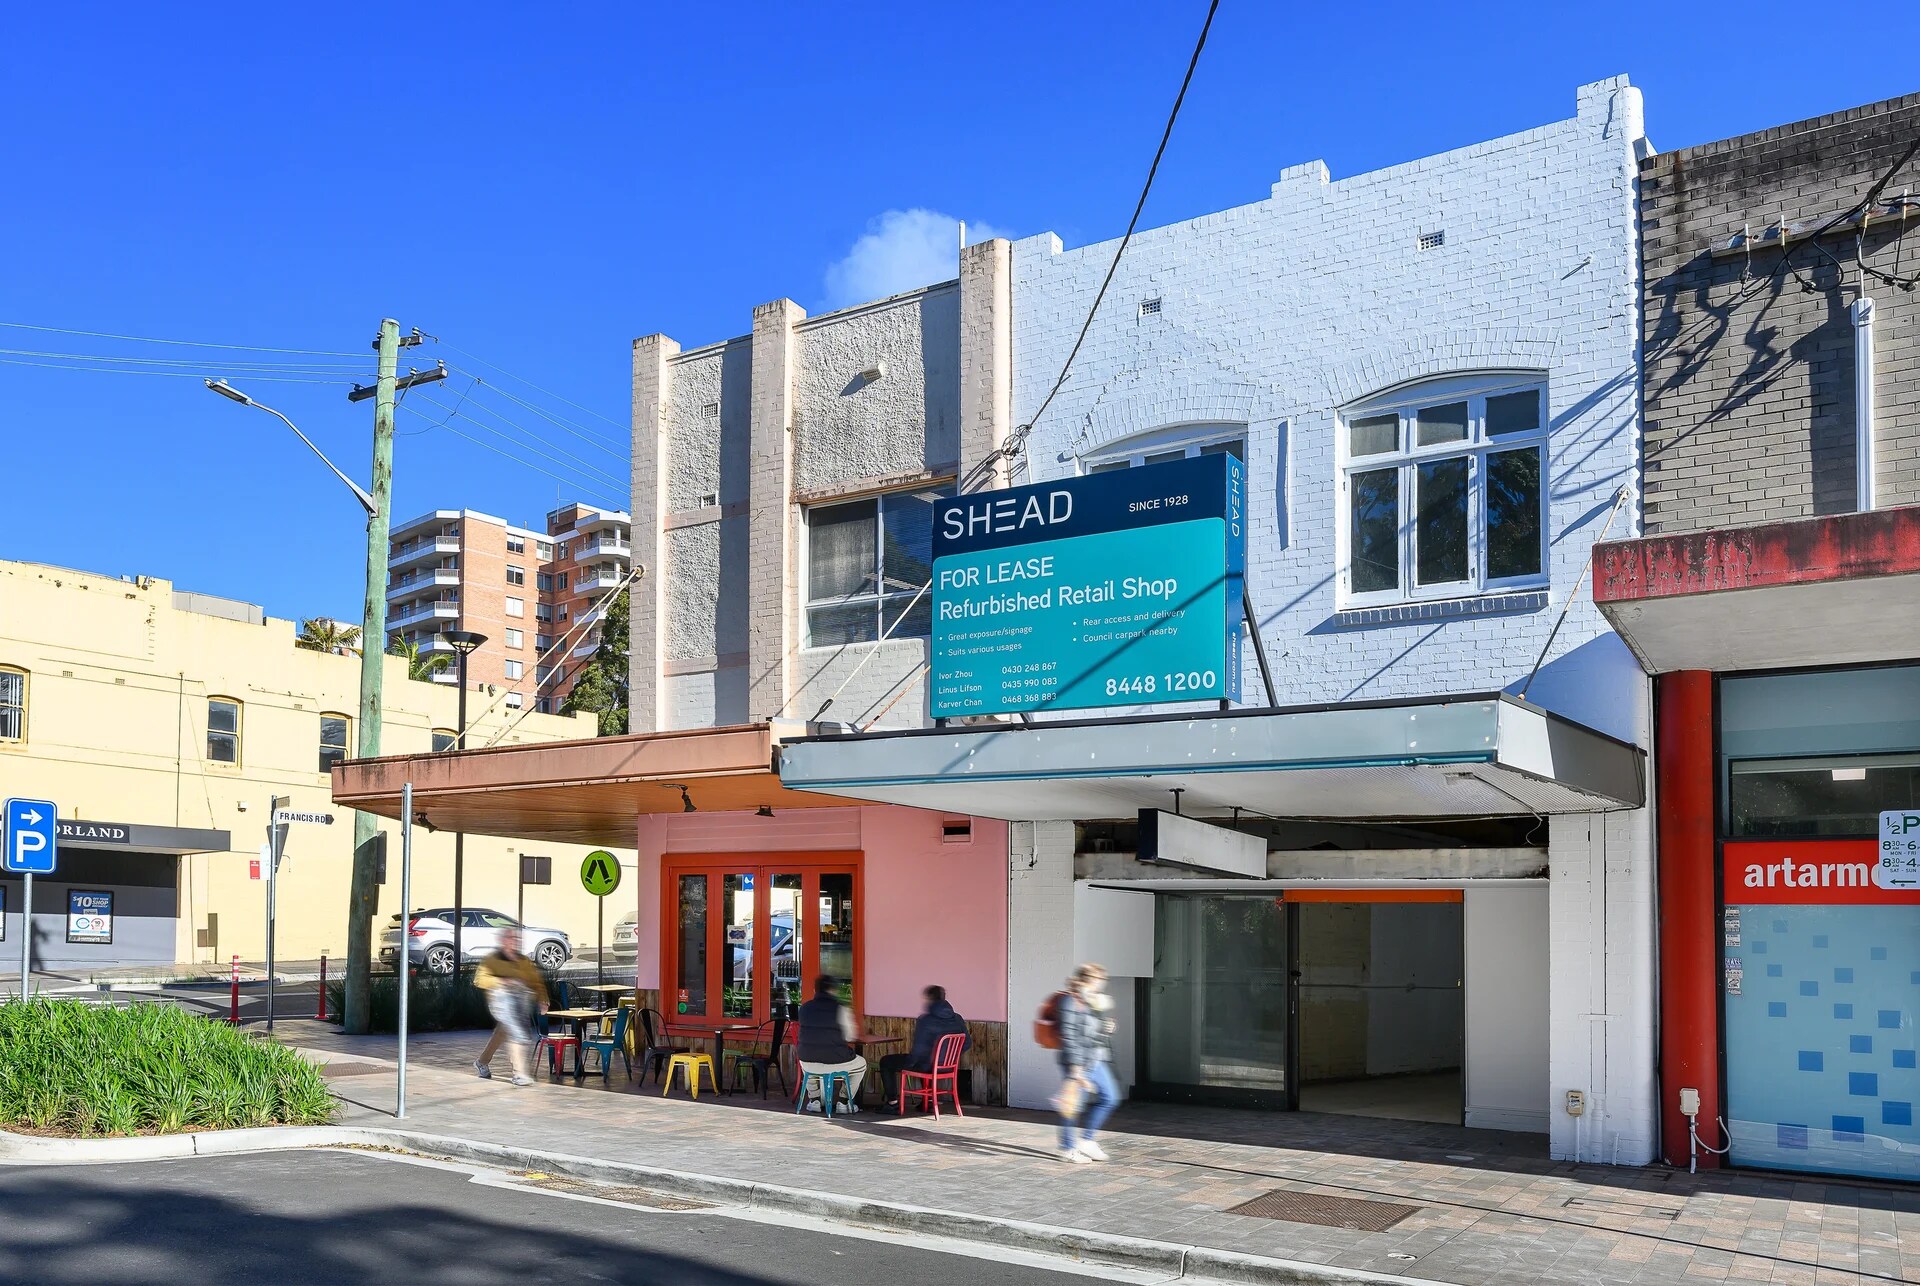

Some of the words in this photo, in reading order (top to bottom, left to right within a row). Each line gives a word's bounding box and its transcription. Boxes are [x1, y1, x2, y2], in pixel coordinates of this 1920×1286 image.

[1128, 499, 1160, 513] SINCE
[1164, 494, 1189, 508] 1928
[1231, 465, 1240, 537] SHEAD
[943, 490, 1073, 540] SHEAD
[940, 566, 980, 591] FOR
[986, 556, 1054, 585] LEASE
[940, 587, 1051, 620] Refurbished
[1058, 580, 1115, 607] Retail
[1121, 576, 1178, 601] Shop
[1083, 617, 1102, 627] Rear
[1104, 614, 1131, 625] access
[1134, 611, 1149, 621] and
[1151, 608, 1186, 620] delivery
[947, 632, 967, 642] Great
[969, 625, 1033, 641] exposure/signage
[1083, 632, 1113, 643] Council
[1115, 628, 1147, 640] carpark
[1149, 625, 1178, 637] nearby
[947, 647, 966, 657] Suits
[967, 645, 995, 654] various
[996, 642, 1022, 653] usages
[938, 672, 952, 680] Ivor
[954, 670, 973, 680] Zhou
[1001, 664, 1022, 675] 0430
[1024, 663, 1040, 673] 248
[1041, 661, 1057, 671] 867
[938, 686, 958, 695] Linus
[959, 683, 983, 693] Lifson
[1001, 679, 1022, 690] 0435
[1023, 678, 1040, 687] 990
[1041, 676, 1058, 687] 083
[1105, 677, 1156, 697] 8448
[1163, 669, 1217, 692] 1200
[938, 700, 962, 710] Karver
[963, 697, 983, 707] Chan
[1001, 694, 1022, 705] 0468
[1024, 693, 1040, 703] 368
[1041, 692, 1057, 702] 883
[280, 812, 314, 822] FRANCIS
[314, 815, 326, 824] RD
[56, 824, 125, 839] RLAND
[16, 829, 47, 863] P
